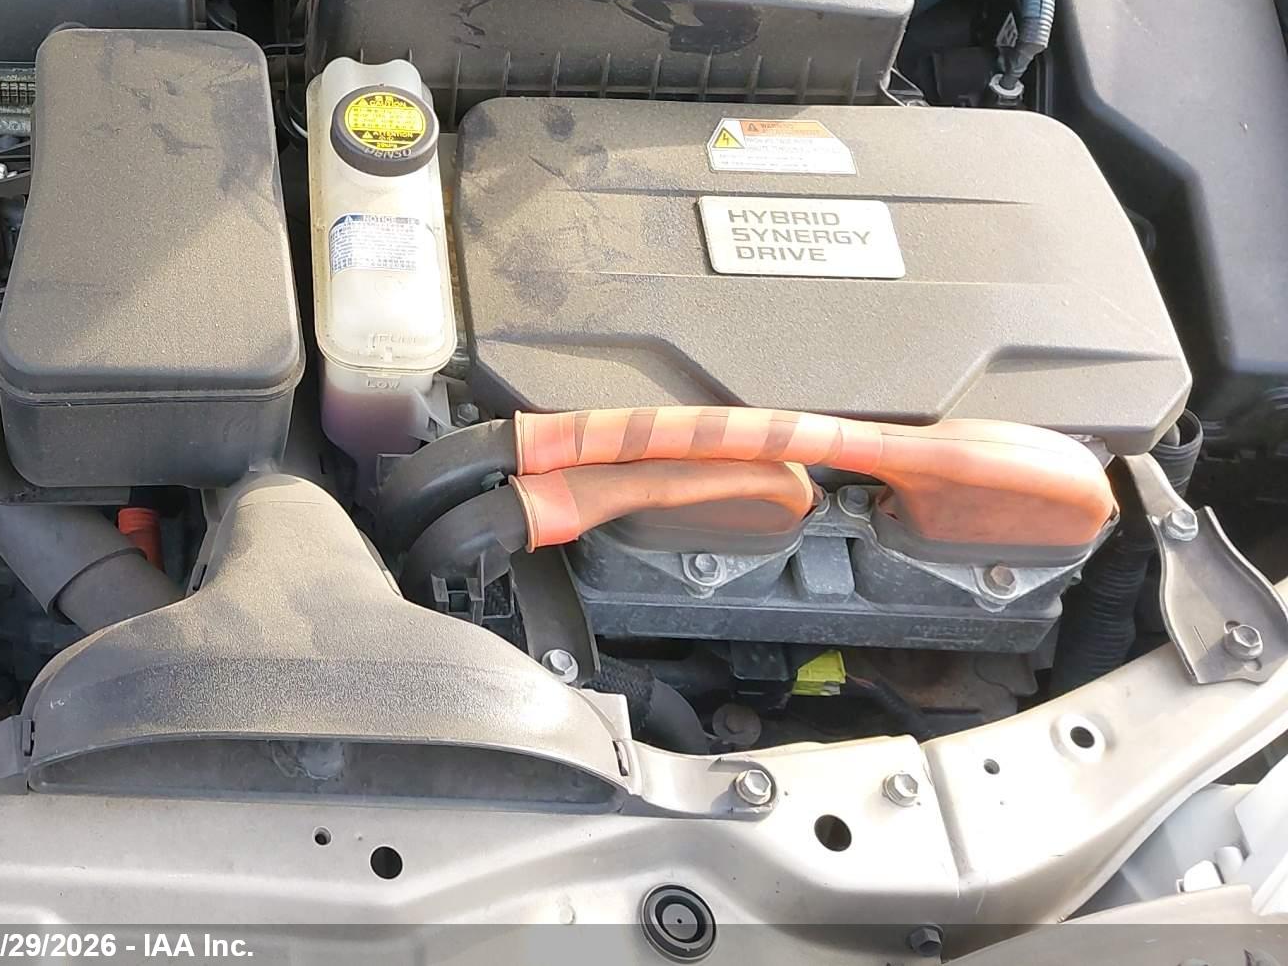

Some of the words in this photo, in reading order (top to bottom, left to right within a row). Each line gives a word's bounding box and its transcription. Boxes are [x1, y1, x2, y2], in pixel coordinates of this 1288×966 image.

[364, 147, 412, 159] DENSO
[727, 210, 841, 226] HYBRID
[731, 227, 872, 246] SYNERGY
[735, 246, 828, 262] DRIVE
[367, 379, 401, 389] LOW
